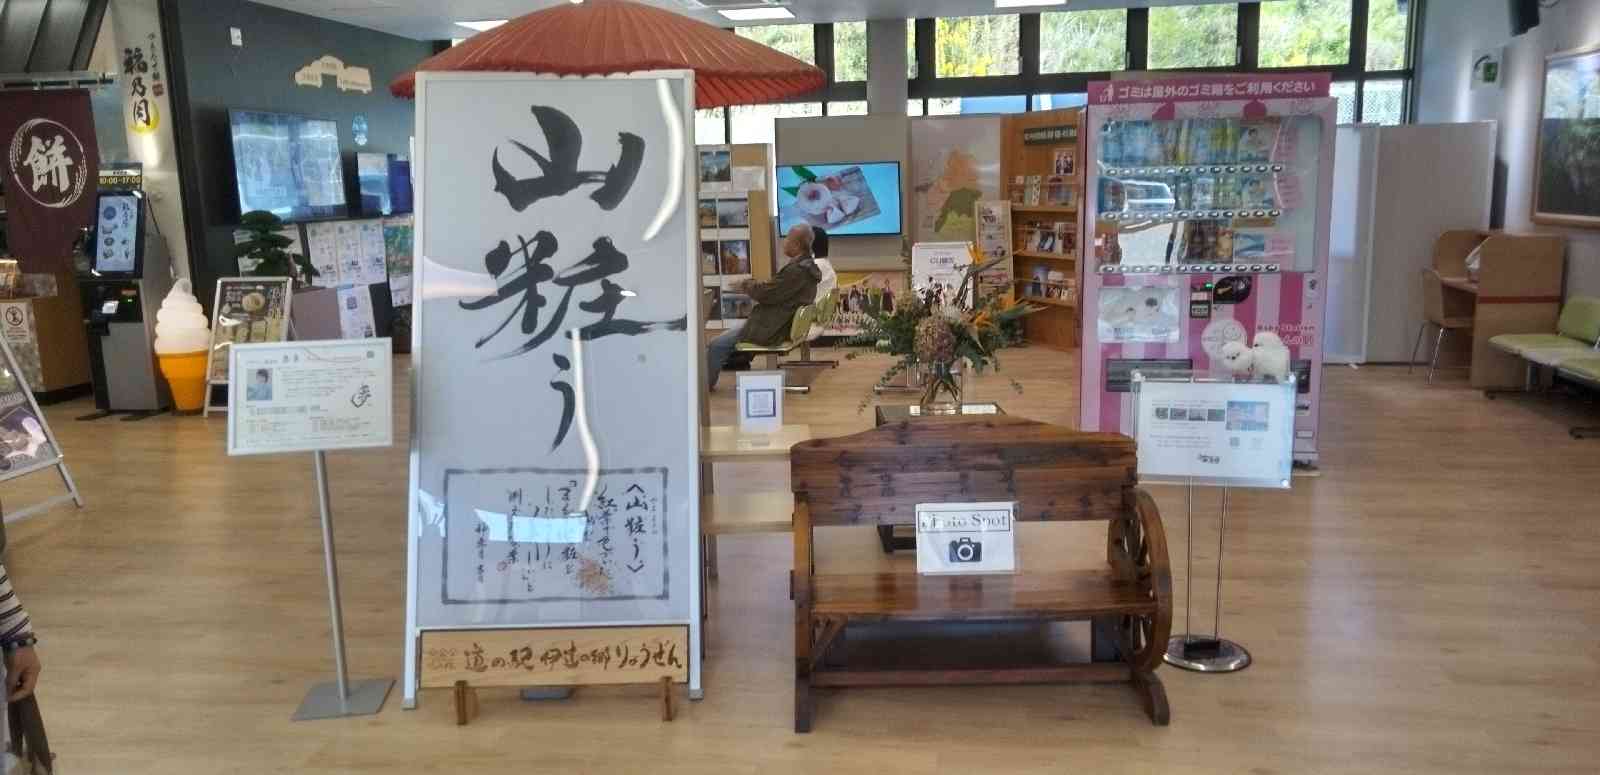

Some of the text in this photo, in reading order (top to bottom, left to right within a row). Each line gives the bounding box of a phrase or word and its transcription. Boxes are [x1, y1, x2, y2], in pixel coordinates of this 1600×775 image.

[1118, 81, 1316, 99] ゴミは屋外のゴミ箱をご利用ください
[23, 135, 73, 192] 餅
